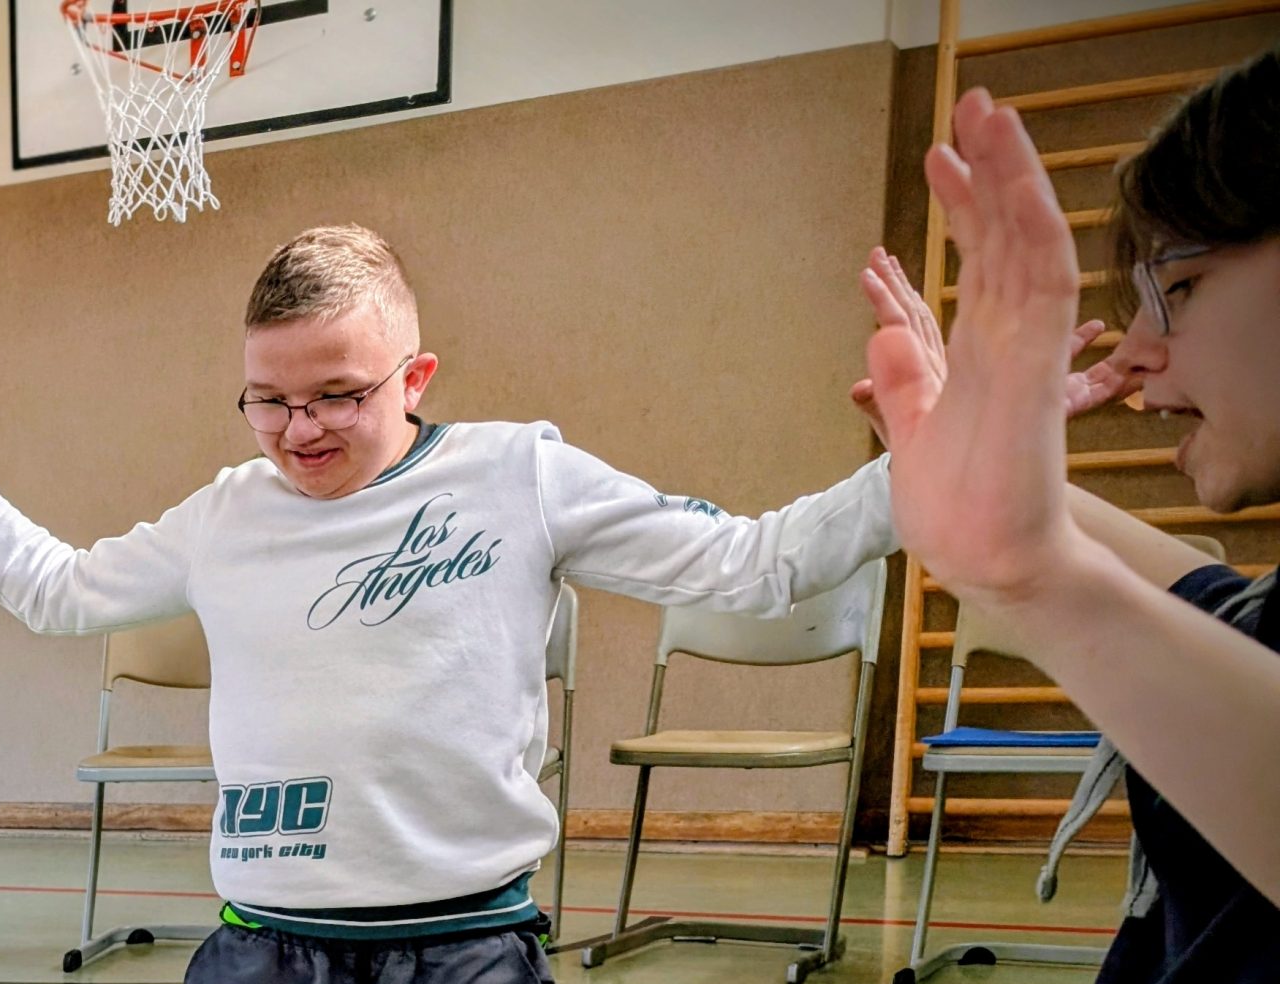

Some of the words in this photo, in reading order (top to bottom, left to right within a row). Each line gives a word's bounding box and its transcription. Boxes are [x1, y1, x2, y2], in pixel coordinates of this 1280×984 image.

[372, 492, 458, 572] Los
[306, 529, 503, 631] Angeles
[241, 844, 273, 862] york
[278, 843, 327, 860] city
